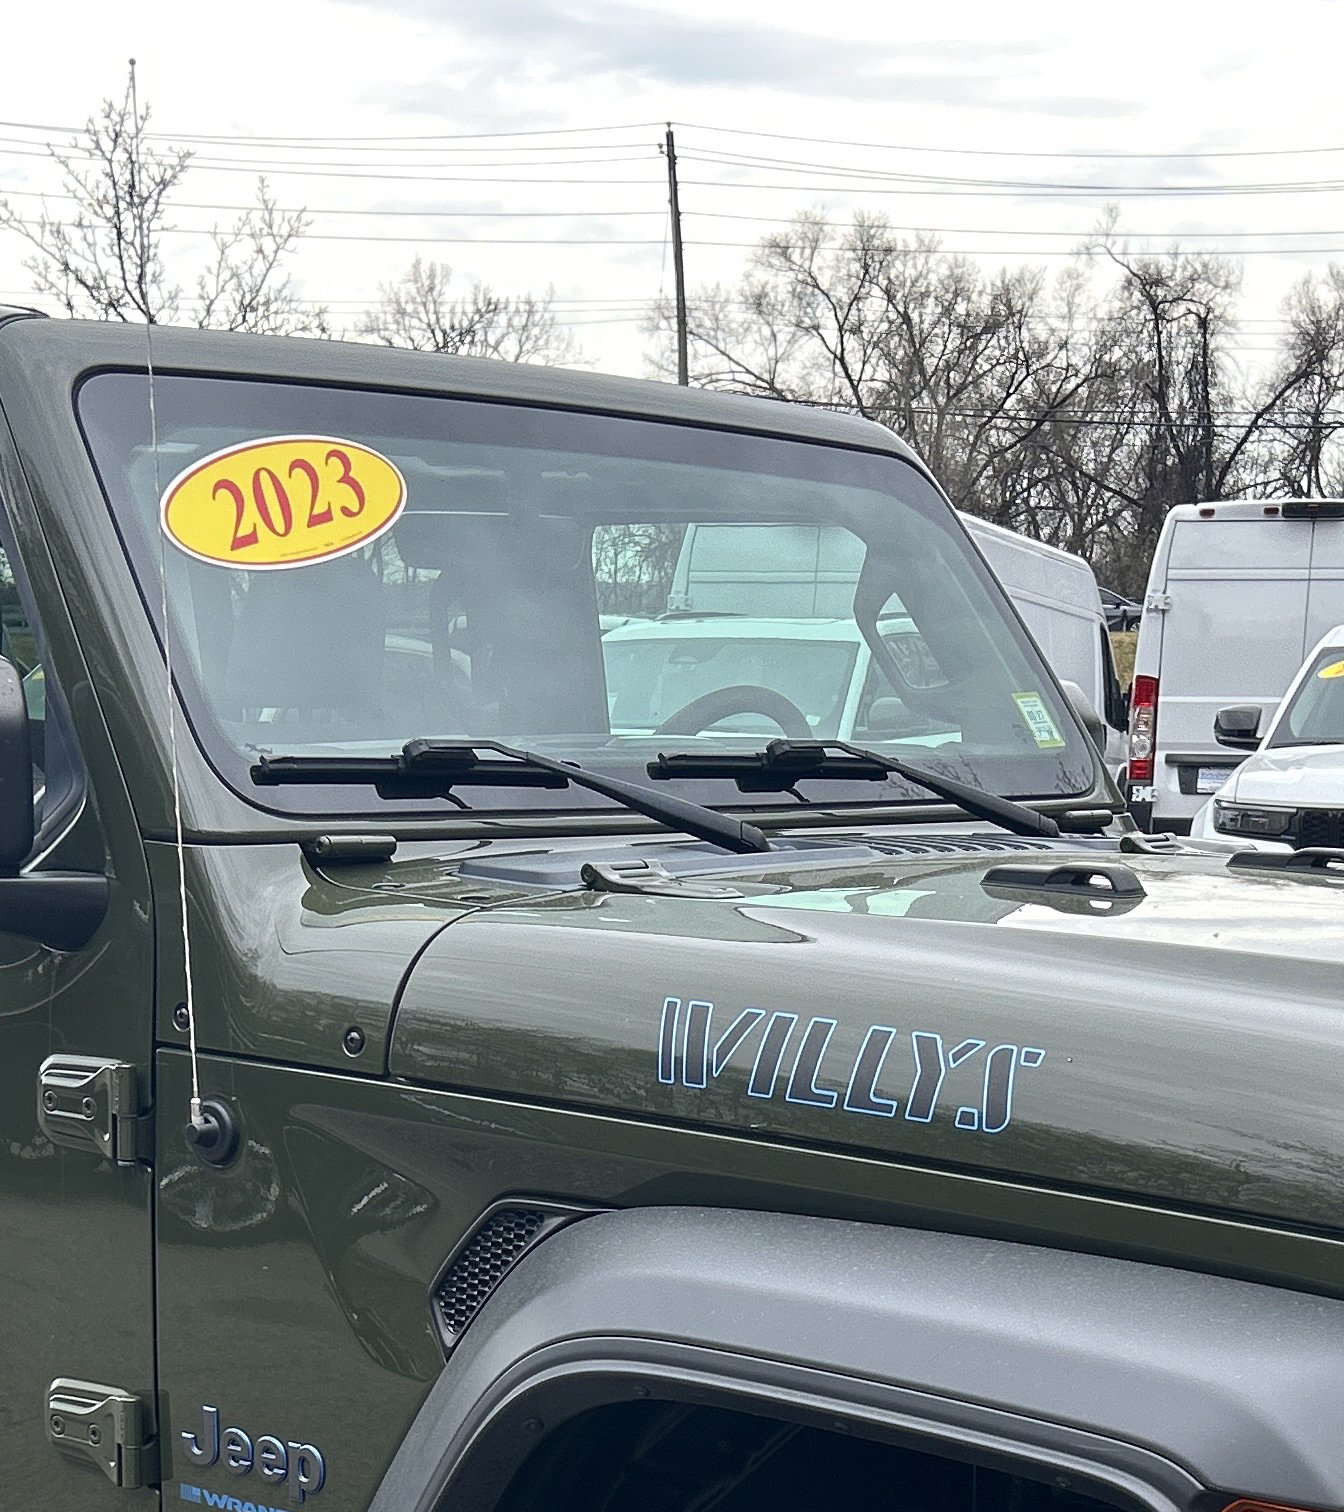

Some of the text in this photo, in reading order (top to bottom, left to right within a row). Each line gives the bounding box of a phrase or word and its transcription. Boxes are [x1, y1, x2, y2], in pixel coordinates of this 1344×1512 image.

[211, 448, 367, 552] 2023
[657, 996, 1047, 1134] WILLYS
[180, 1404, 327, 1504] Jeep
